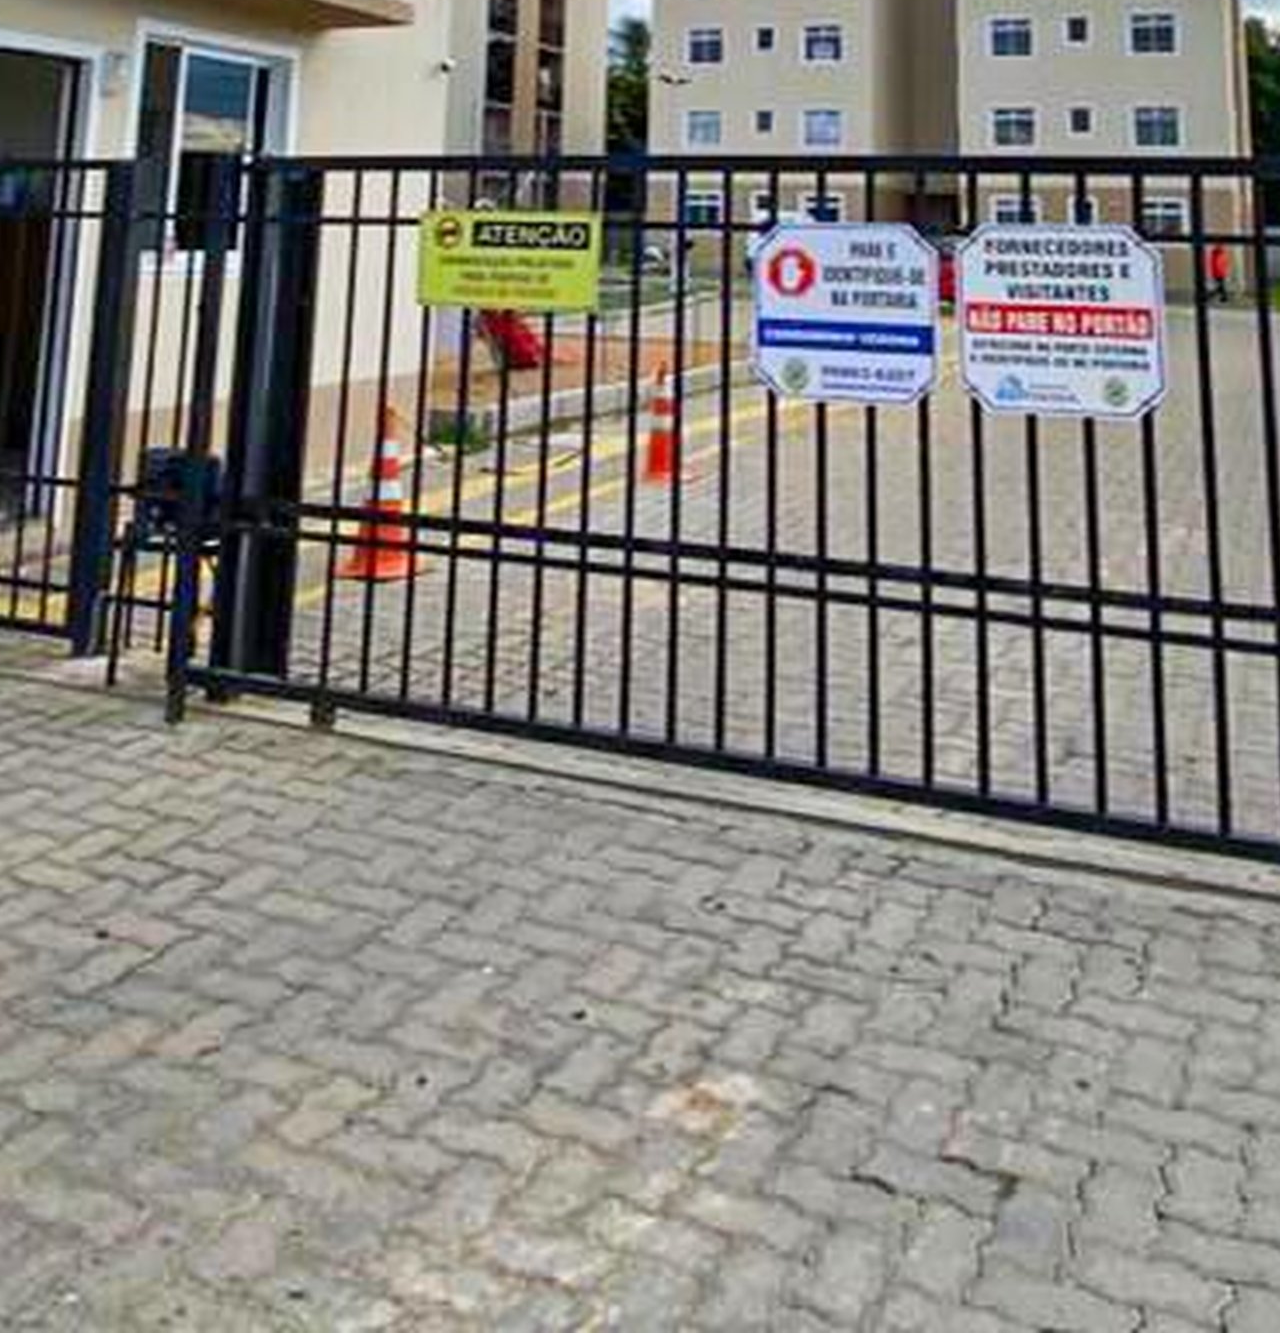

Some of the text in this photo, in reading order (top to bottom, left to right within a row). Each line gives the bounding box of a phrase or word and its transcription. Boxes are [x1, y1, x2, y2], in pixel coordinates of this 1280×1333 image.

[477, 223, 587, 247] ATENÇÃO
[985, 238, 1130, 257] FORNECEDORES
[985, 260, 1130, 279] PRESTADORES E
[1007, 282, 1110, 302] VISITANTES
[970, 307, 1149, 336] NÃO PARE NO PORTÃO
